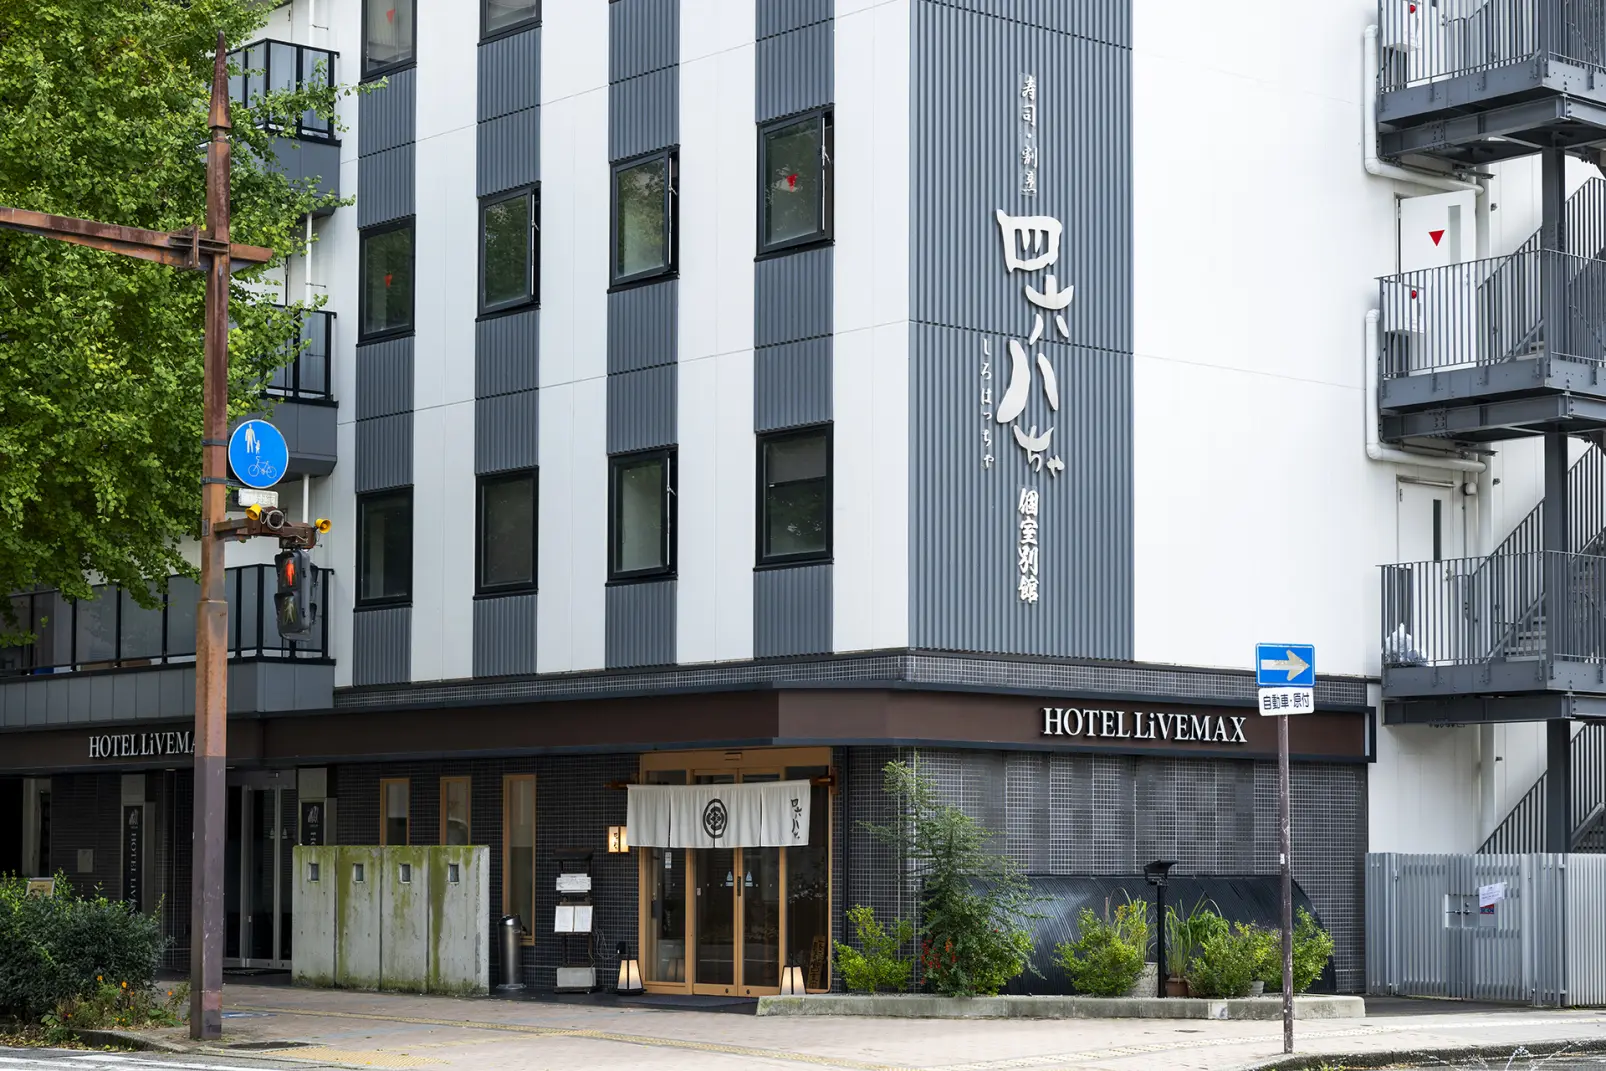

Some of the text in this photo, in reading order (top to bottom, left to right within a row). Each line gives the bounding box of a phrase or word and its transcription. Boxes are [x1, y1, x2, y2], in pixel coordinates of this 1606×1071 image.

[980, 338, 995, 469] しろはっちゃ
[1018, 488, 1039, 603] 個室別館
[88, 731, 195, 758] HOTEL LiVEM
[1042, 707, 1248, 743] HOTEL LiVEMAX
